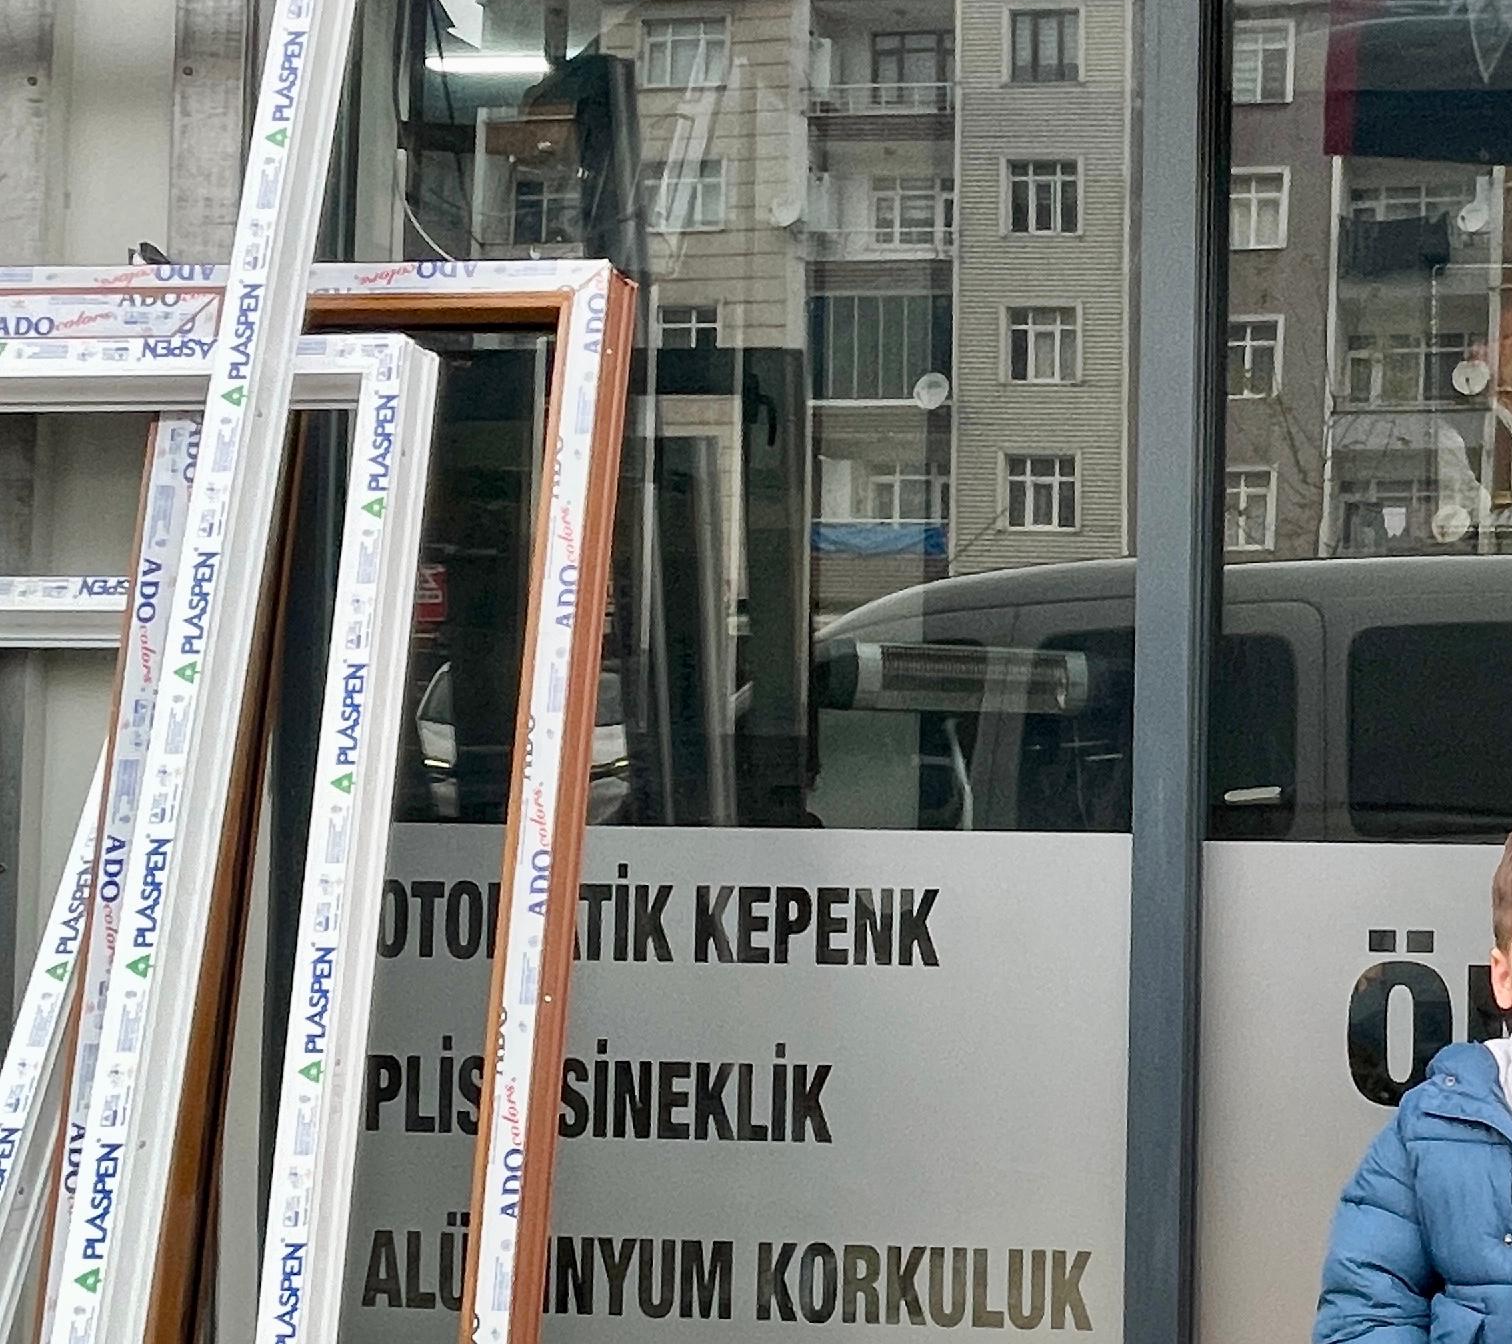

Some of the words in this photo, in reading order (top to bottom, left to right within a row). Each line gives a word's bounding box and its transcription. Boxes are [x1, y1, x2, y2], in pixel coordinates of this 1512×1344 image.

[271, 30, 308, 122] PLASPEN
[142, 338, 218, 360] ASPEN
[227, 282, 264, 380] PLASPEN
[367, 393, 400, 492] PLASPEN
[181, 552, 220, 654] PLASPEN
[336, 661, 368, 766] PLASPEN
[133, 838, 172, 948] PLASPEN
[375, 862, 674, 963] OTOTİK
[694, 884, 940, 968] KEPENK
[305, 945, 337, 1054] PLASPEN
[365, 1035, 487, 1134] PLİS
[557, 1038, 834, 1145] SİNEKLİK
[83, 1143, 123, 1260] PLASPEN
[361, 1211, 735, 1322] ALÜNYUM
[755, 1240, 1094, 1333] KORKULUK
